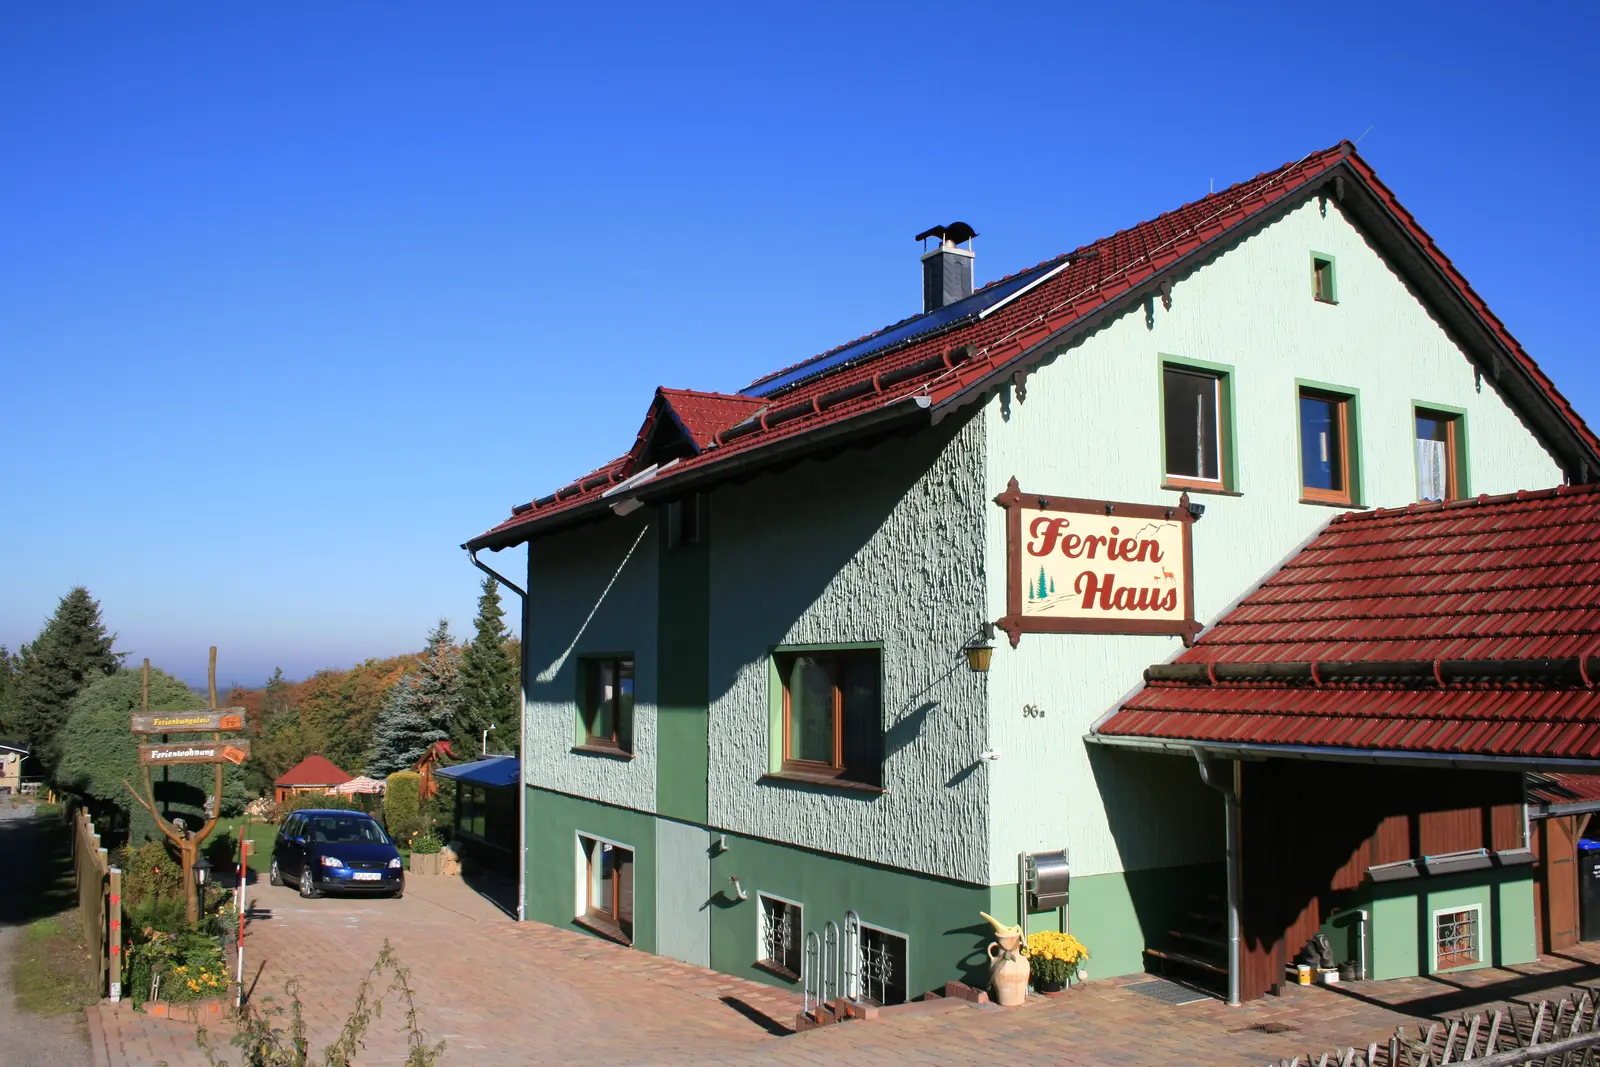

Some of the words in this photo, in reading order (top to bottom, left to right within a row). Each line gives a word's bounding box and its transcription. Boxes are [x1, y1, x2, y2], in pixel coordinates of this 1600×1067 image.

[1027, 516, 1165, 563] Ferien
[1074, 570, 1178, 612] Haus
[151, 747, 215, 759] Ferienwohnung
